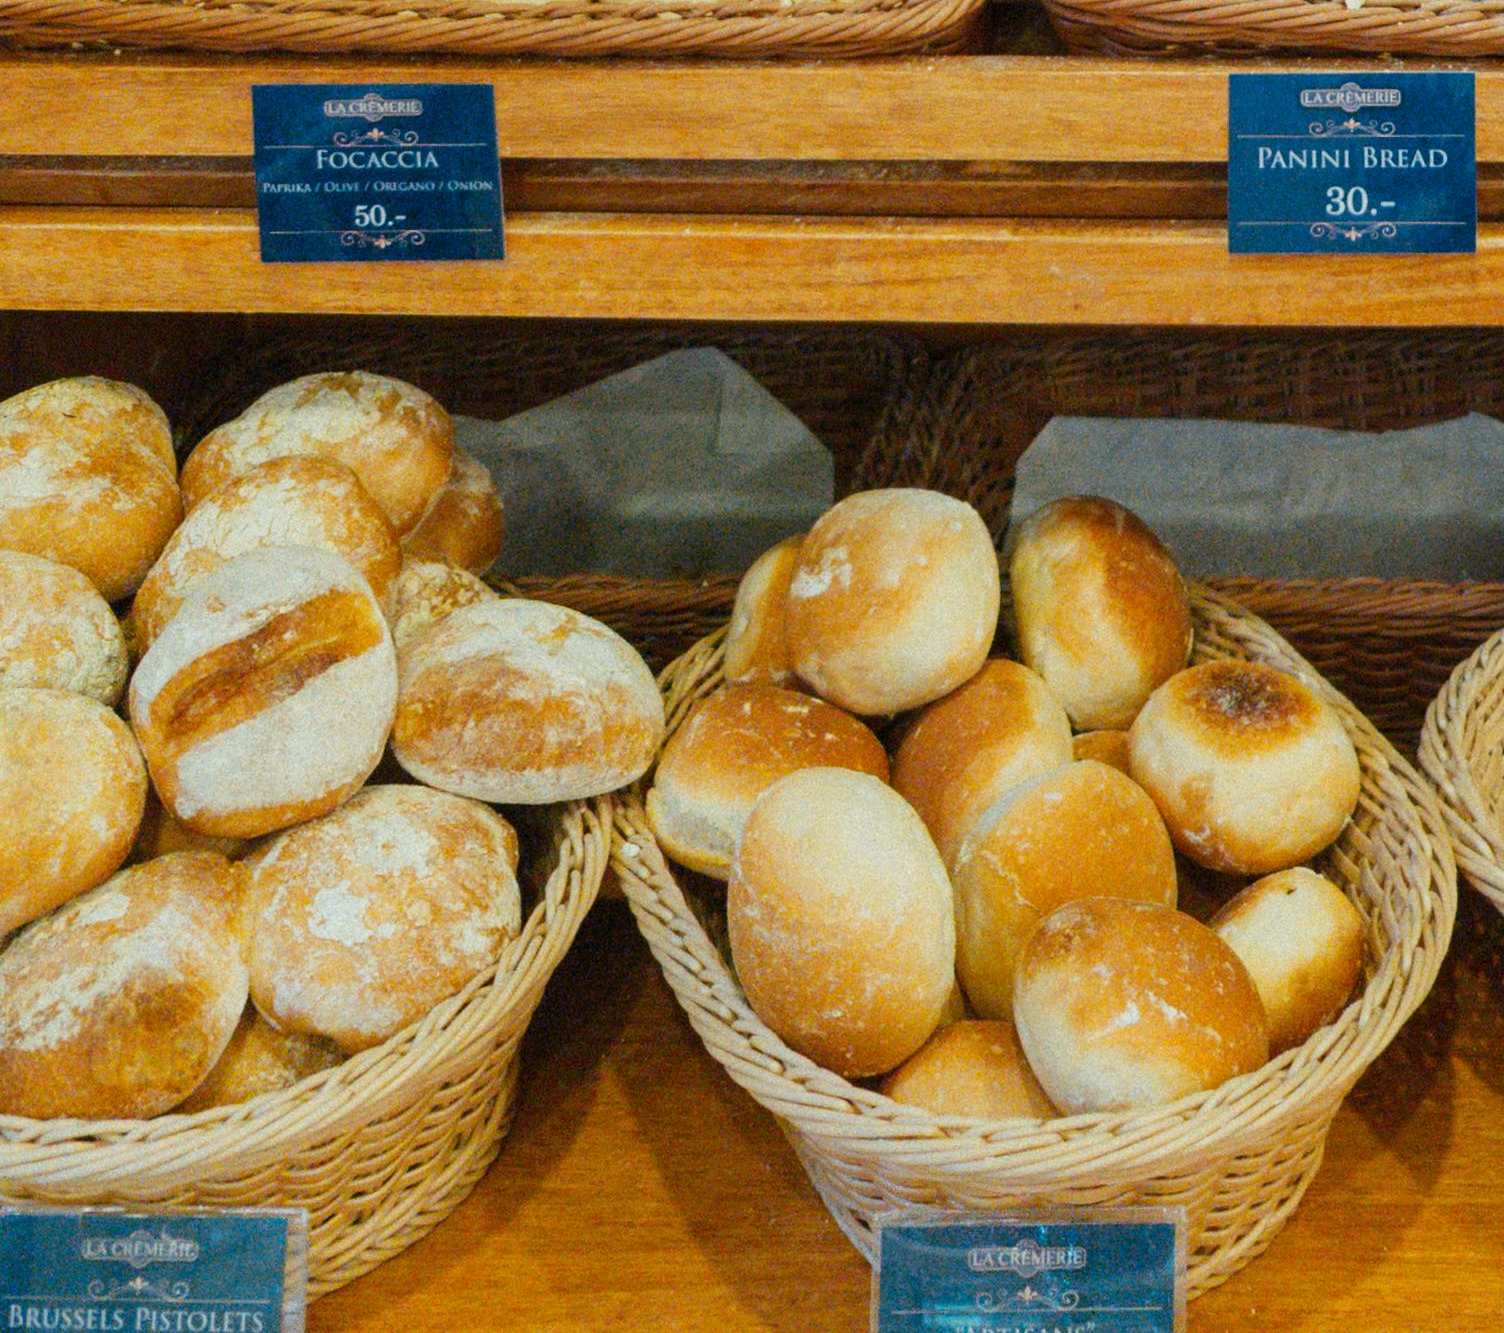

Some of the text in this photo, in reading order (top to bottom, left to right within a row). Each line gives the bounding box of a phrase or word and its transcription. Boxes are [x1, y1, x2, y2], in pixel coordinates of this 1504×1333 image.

[1304, 91, 1323, 103] LA
[328, 102, 346, 114] LA
[316, 149, 439, 170] FOCACCIA
[1258, 146, 1449, 169] PANINI BREAD
[262, 181, 312, 193] PAPRIKA
[323, 181, 360, 192] OLIVE
[373, 180, 436, 191] OREGANO
[447, 179, 493, 191] ONION
[1325, 186, 1396, 216] 30.-
[354, 204, 407, 227] 50.-
[85, 1239, 107, 1256] LA
[972, 1249, 994, 1266] LA
[8, 1303, 264, 1333] BRUSSELS PISTOLETS
